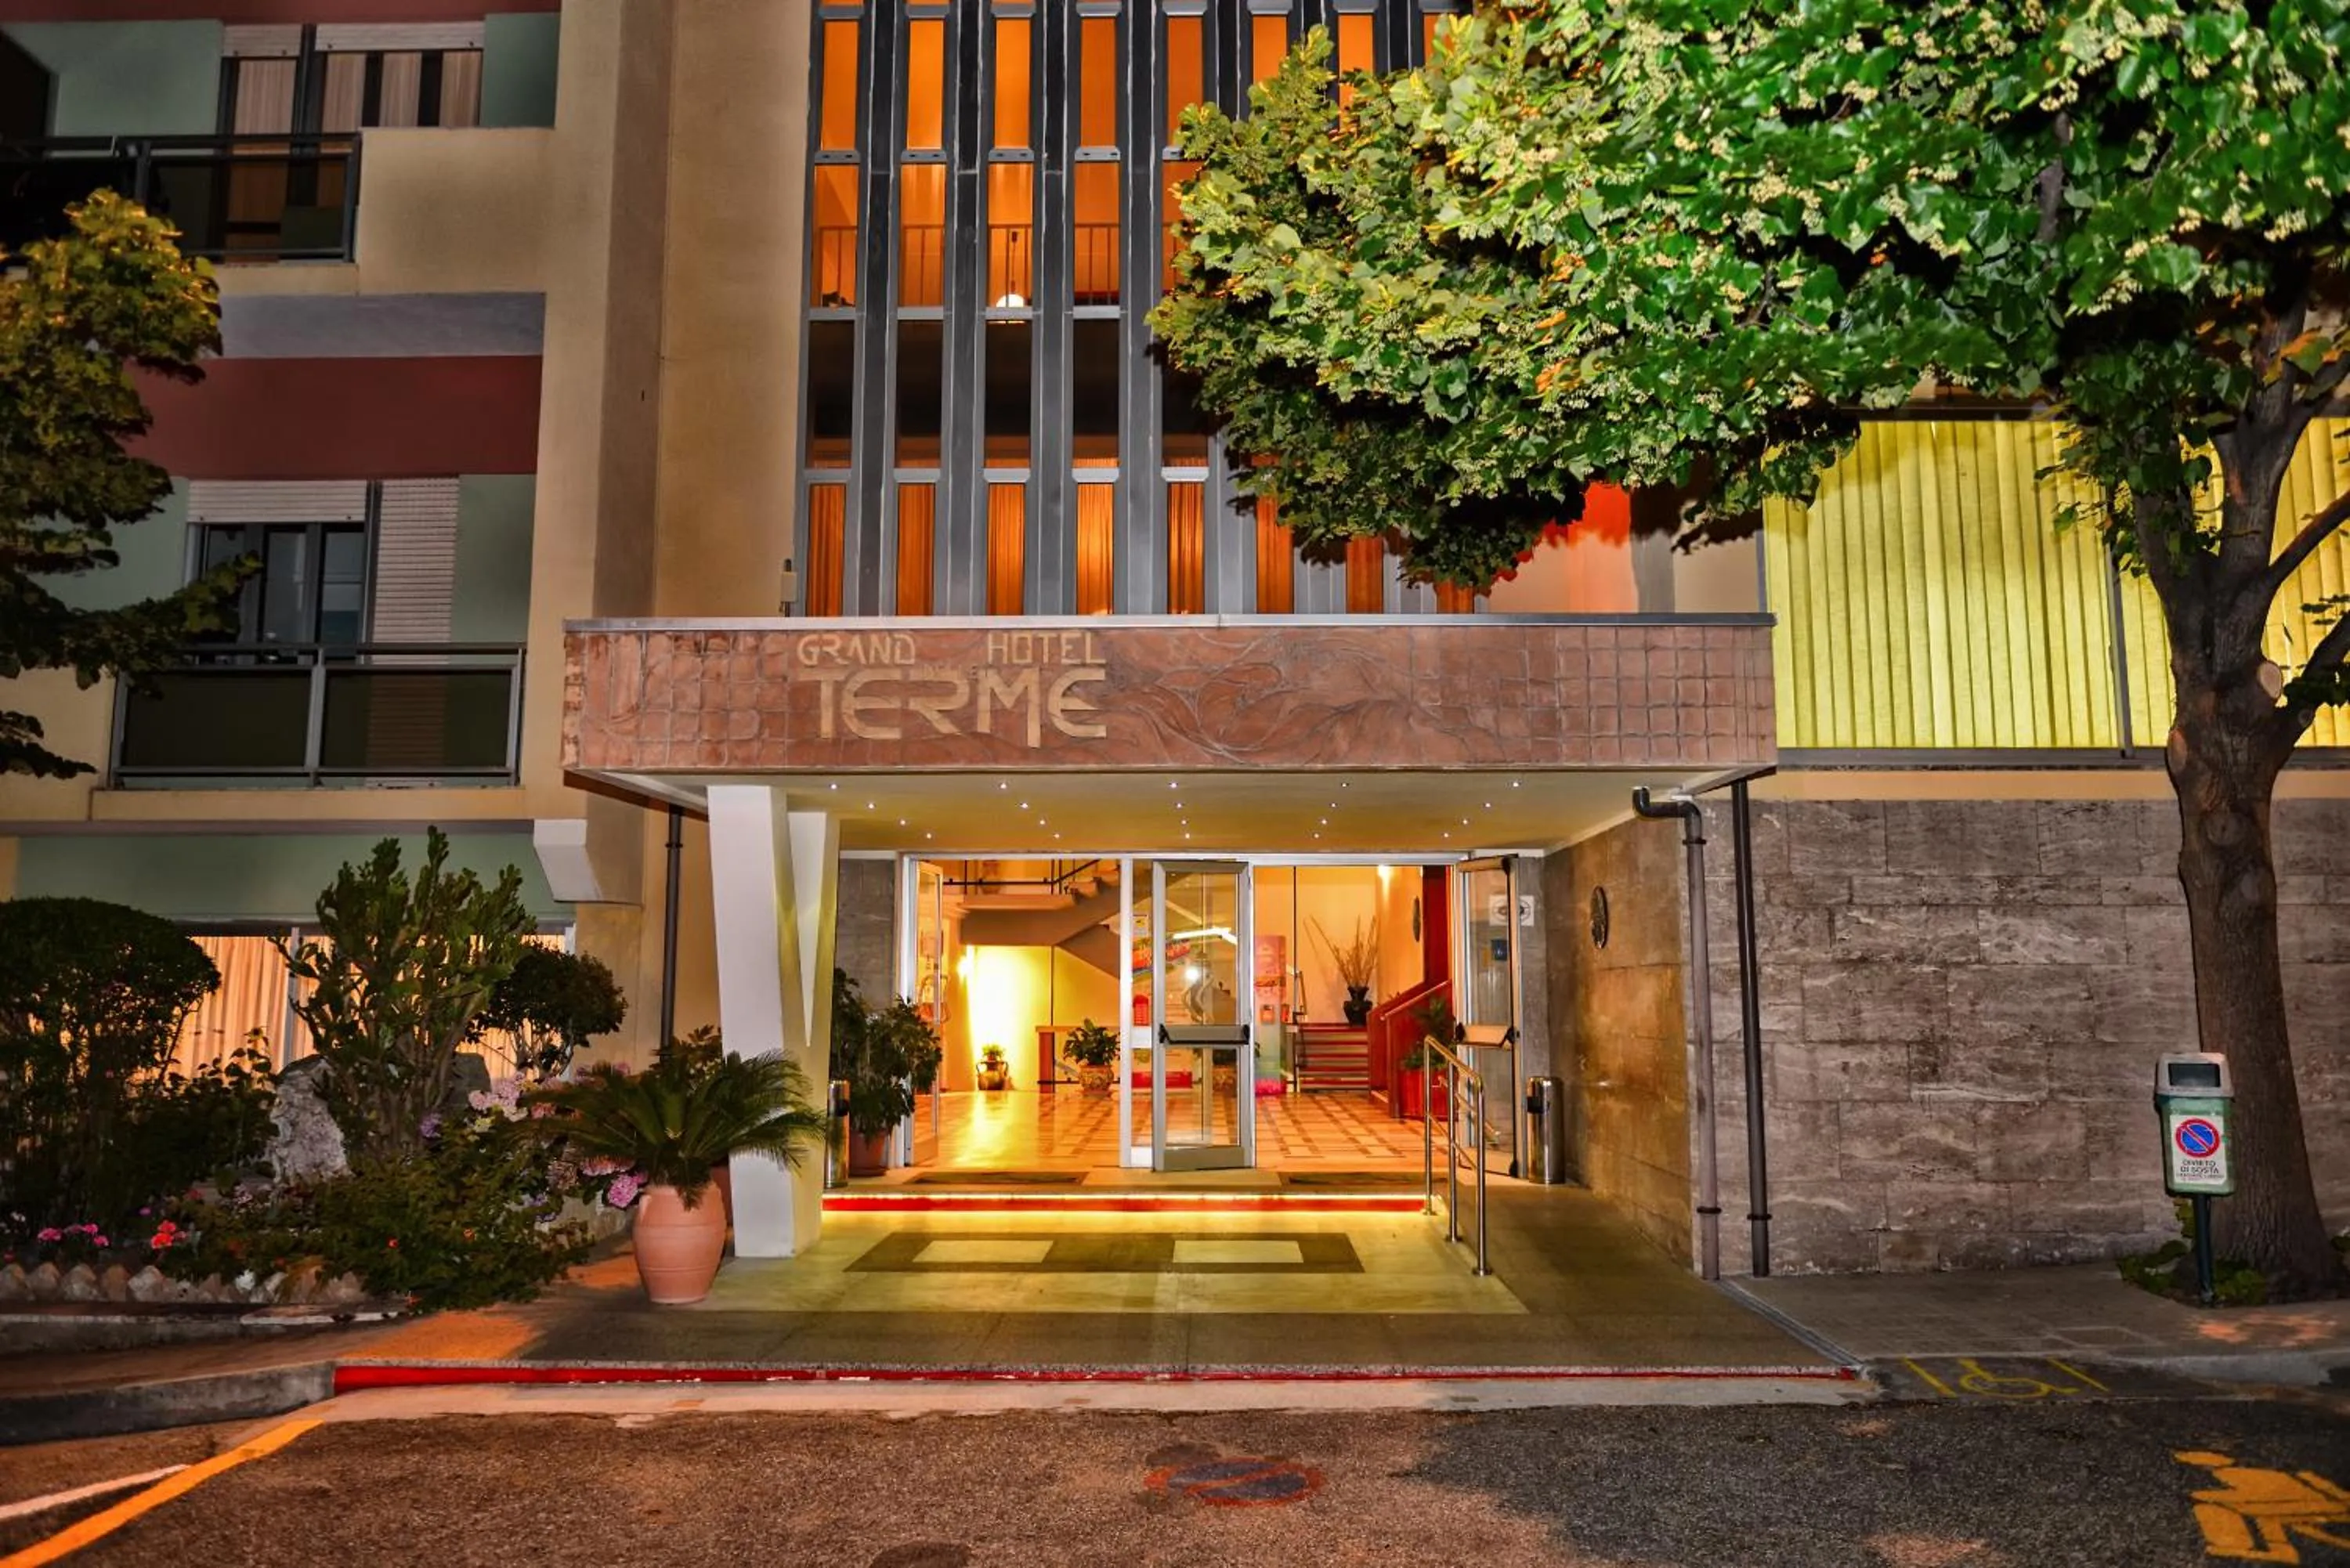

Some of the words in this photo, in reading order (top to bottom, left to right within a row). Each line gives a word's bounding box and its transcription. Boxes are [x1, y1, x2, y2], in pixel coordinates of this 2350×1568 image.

[797, 633, 915, 666] GRAND
[987, 630, 1107, 664] HOTEL
[798, 666, 1107, 748] TERME
